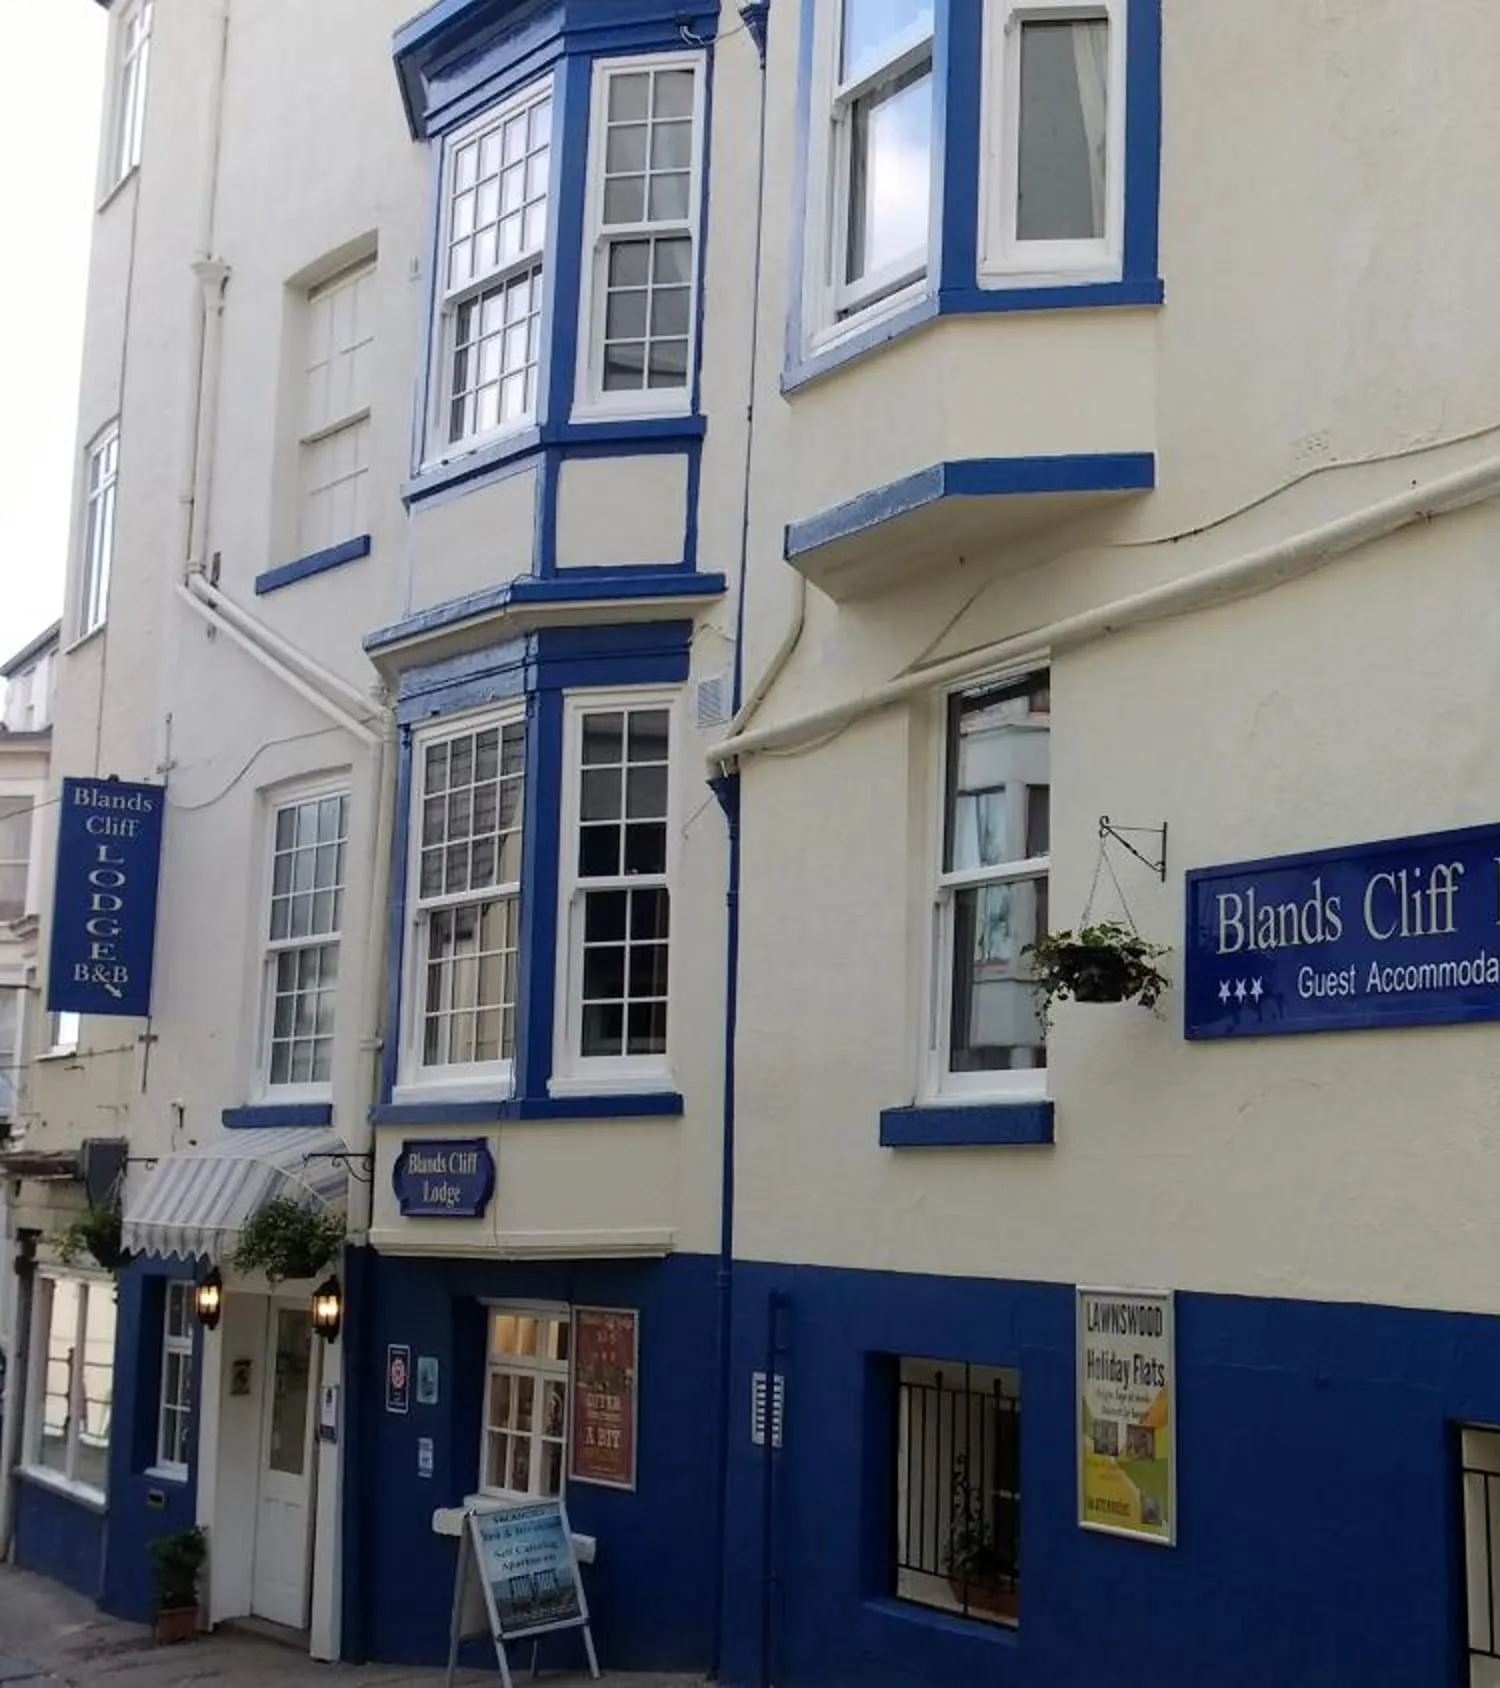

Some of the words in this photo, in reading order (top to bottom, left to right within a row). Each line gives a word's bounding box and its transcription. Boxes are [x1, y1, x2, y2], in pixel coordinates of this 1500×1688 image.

[72, 786, 153, 813] Blands
[85, 814, 141, 837] Cliff
[85, 844, 126, 961] LODGE
[1215, 877, 1342, 956] Blands
[1362, 861, 1465, 942] Cliff
[73, 962, 129, 984] B&B
[1298, 962, 1357, 999] Guest
[408, 1151, 446, 1174] Blands
[449, 1151, 478, 1174] Cliff
[422, 1180, 461, 1208] Lodge
[1086, 1301, 1163, 1338] LAWNSWOOD
[1086, 1347, 1131, 1391] Holiday
[1133, 1352, 1166, 1388] Flats
